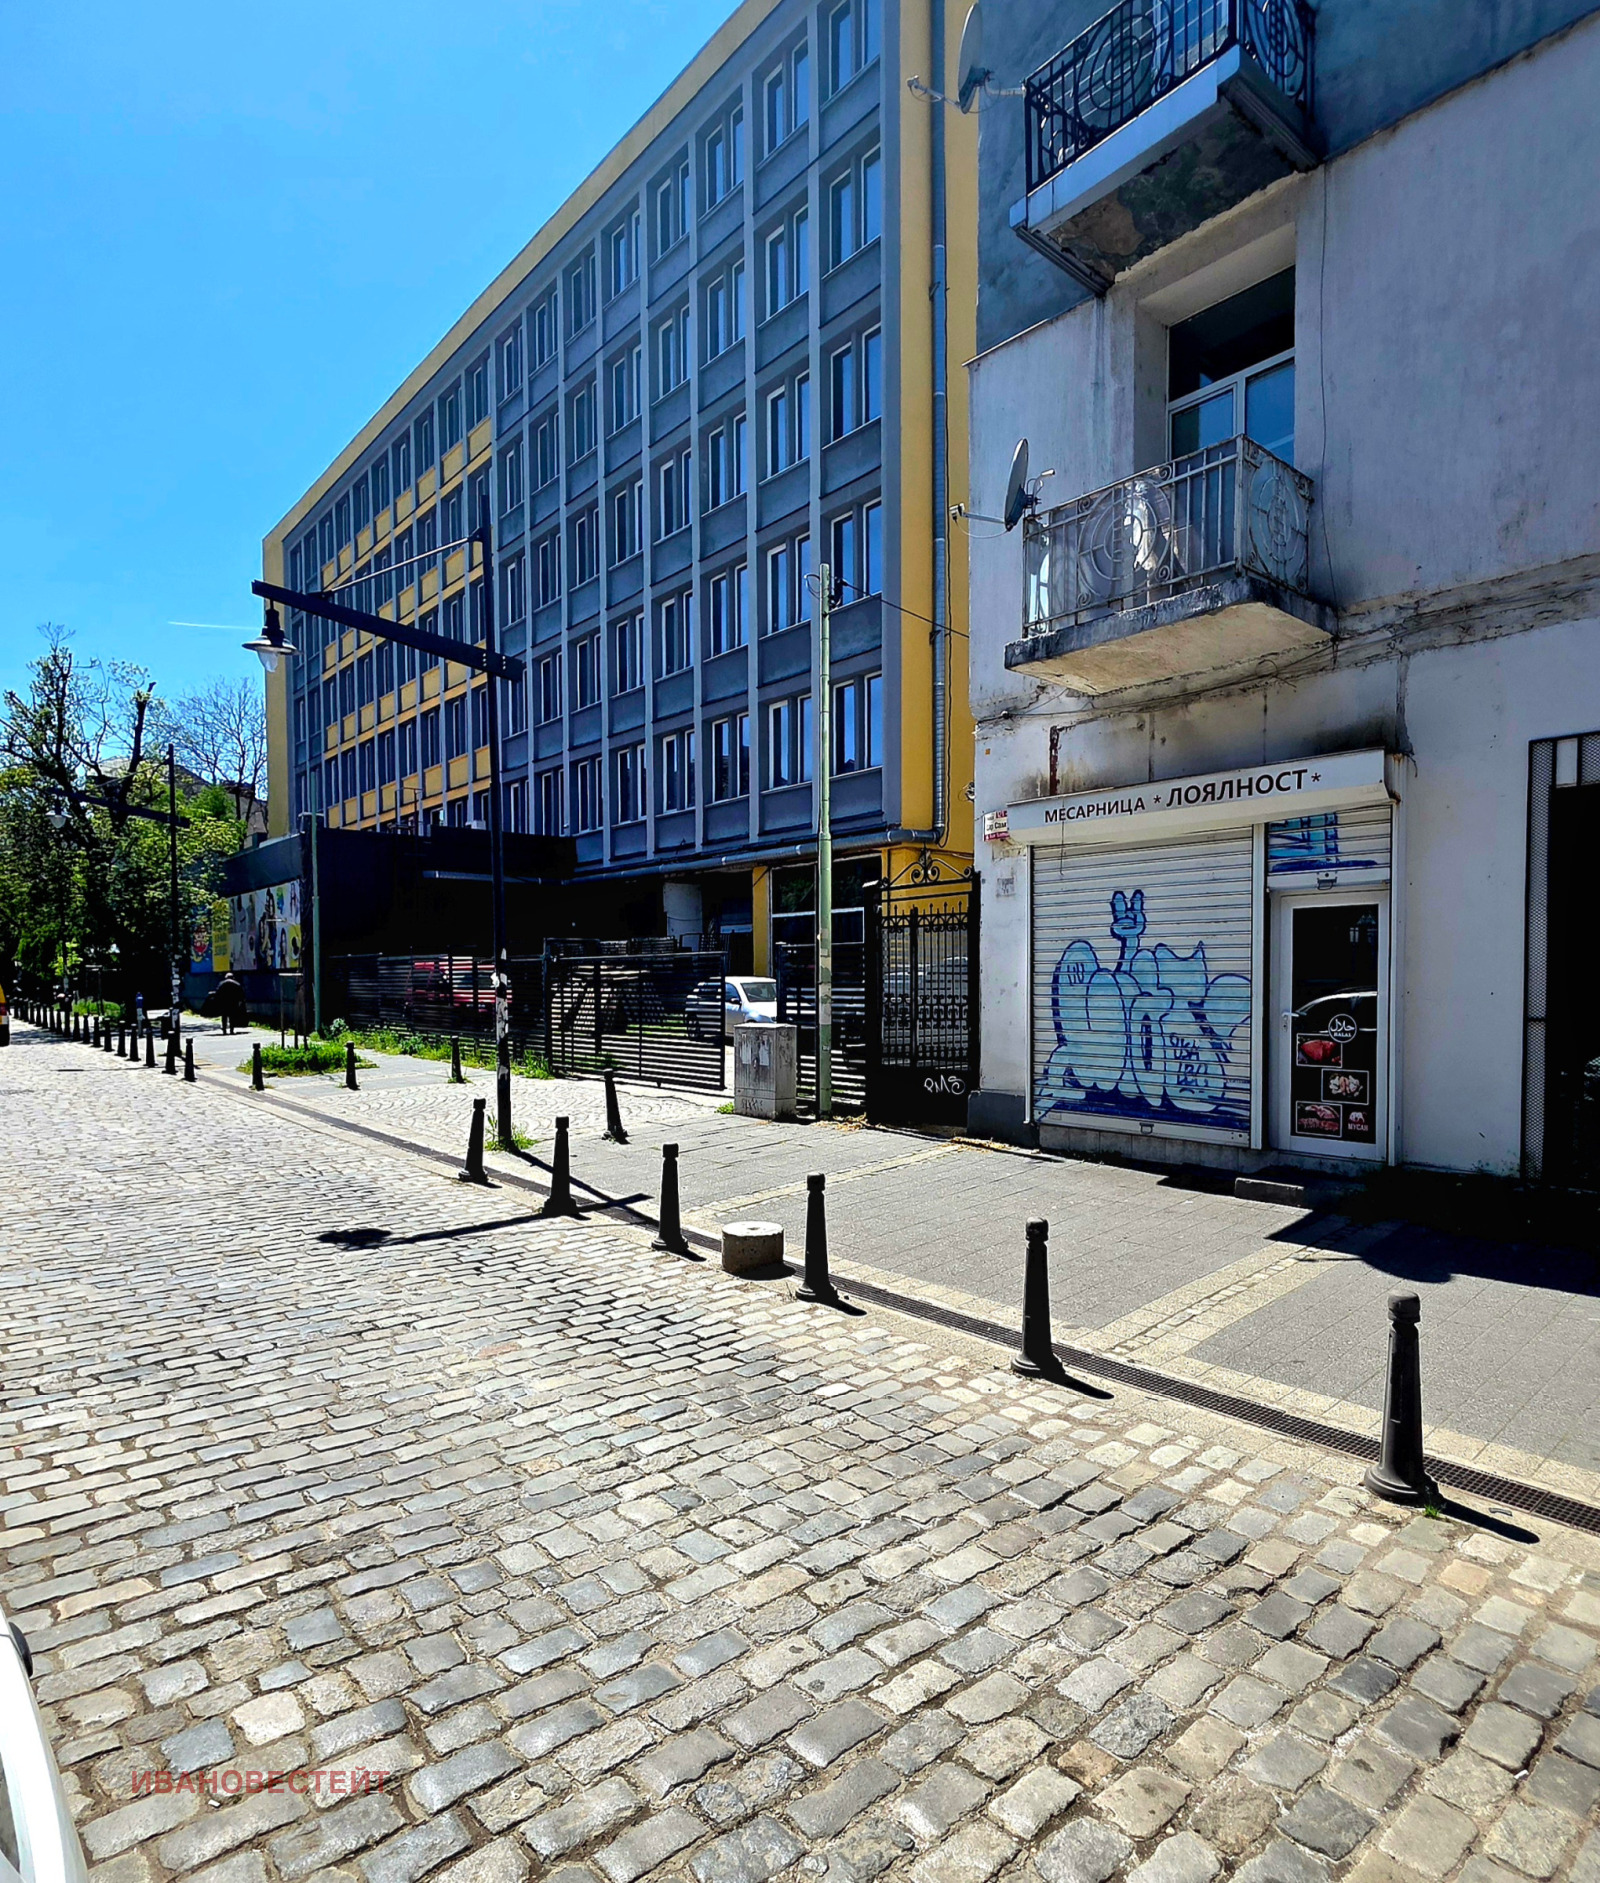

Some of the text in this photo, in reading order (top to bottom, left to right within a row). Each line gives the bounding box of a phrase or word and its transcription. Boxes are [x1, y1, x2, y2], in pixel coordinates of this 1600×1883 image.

[1045, 769, 1308, 823] МЕСАРНИЦА ЛОЯЛНОСТ
[1330, 1019, 1355, 1031] حلال
